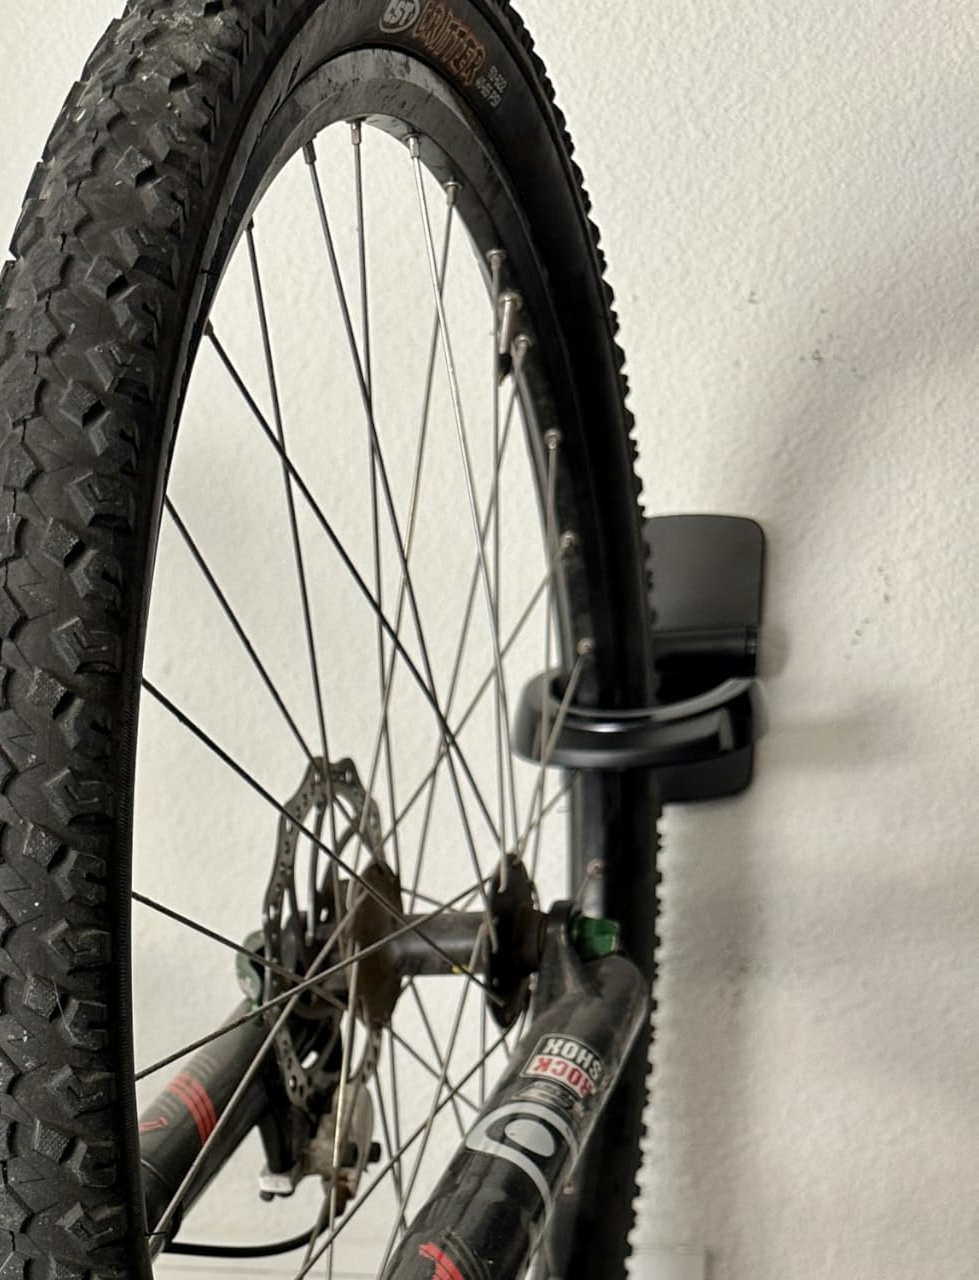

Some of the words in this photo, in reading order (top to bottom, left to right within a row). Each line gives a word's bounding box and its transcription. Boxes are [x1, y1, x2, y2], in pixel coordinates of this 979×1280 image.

[413, 2, 486, 87] CRITTER
[533, 1056, 593, 1096] ROCK
[543, 1038, 602, 1080] SHOX
